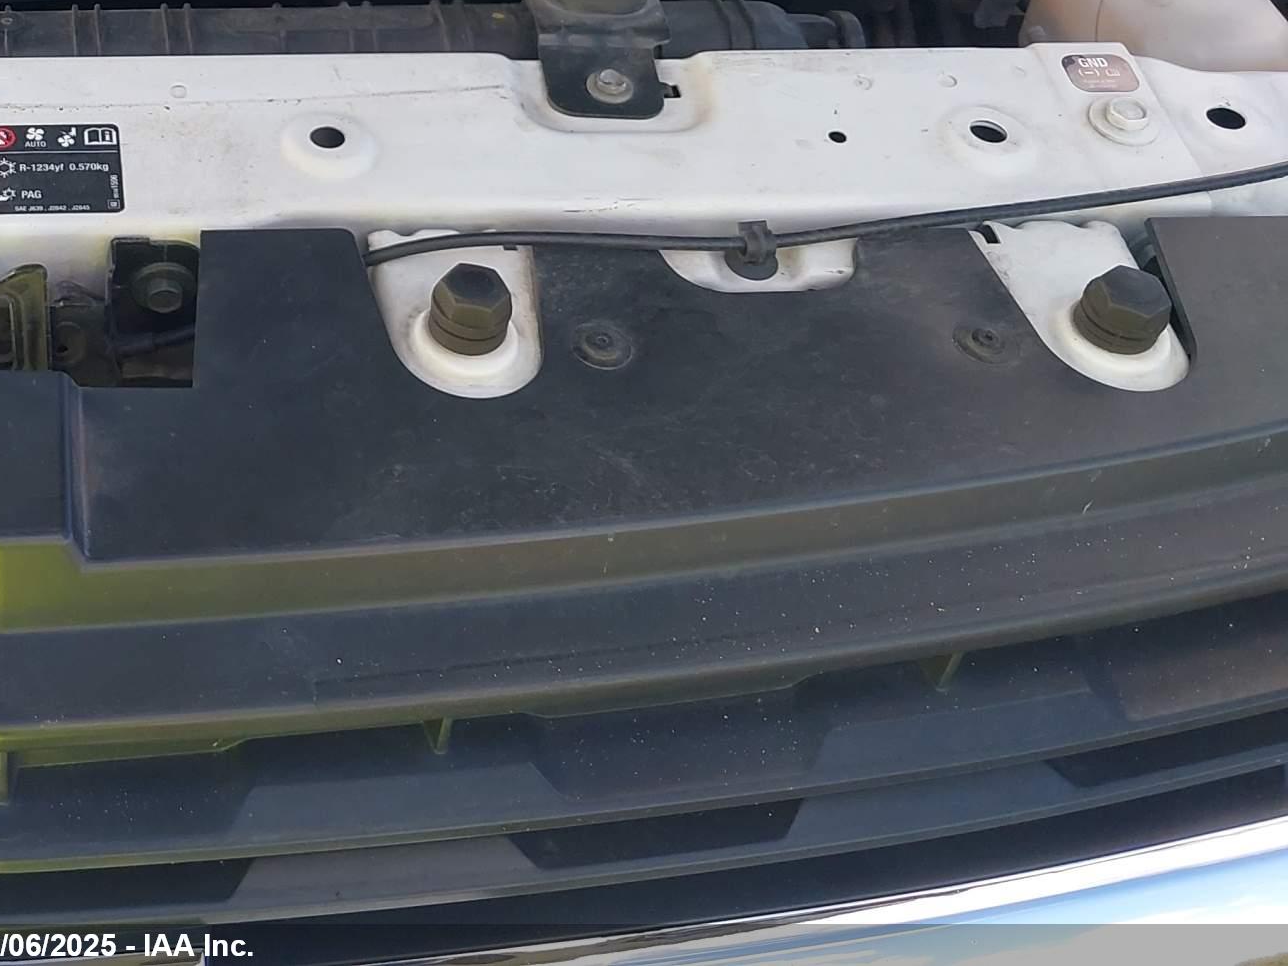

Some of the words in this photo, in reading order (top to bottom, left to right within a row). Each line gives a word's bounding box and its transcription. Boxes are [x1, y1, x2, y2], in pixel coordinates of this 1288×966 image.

[1078, 57, 1108, 68] GND
[19, 163, 64, 173] R-1234yf
[69, 162, 109, 172] 0.570kg
[21, 190, 42, 199] PAG
